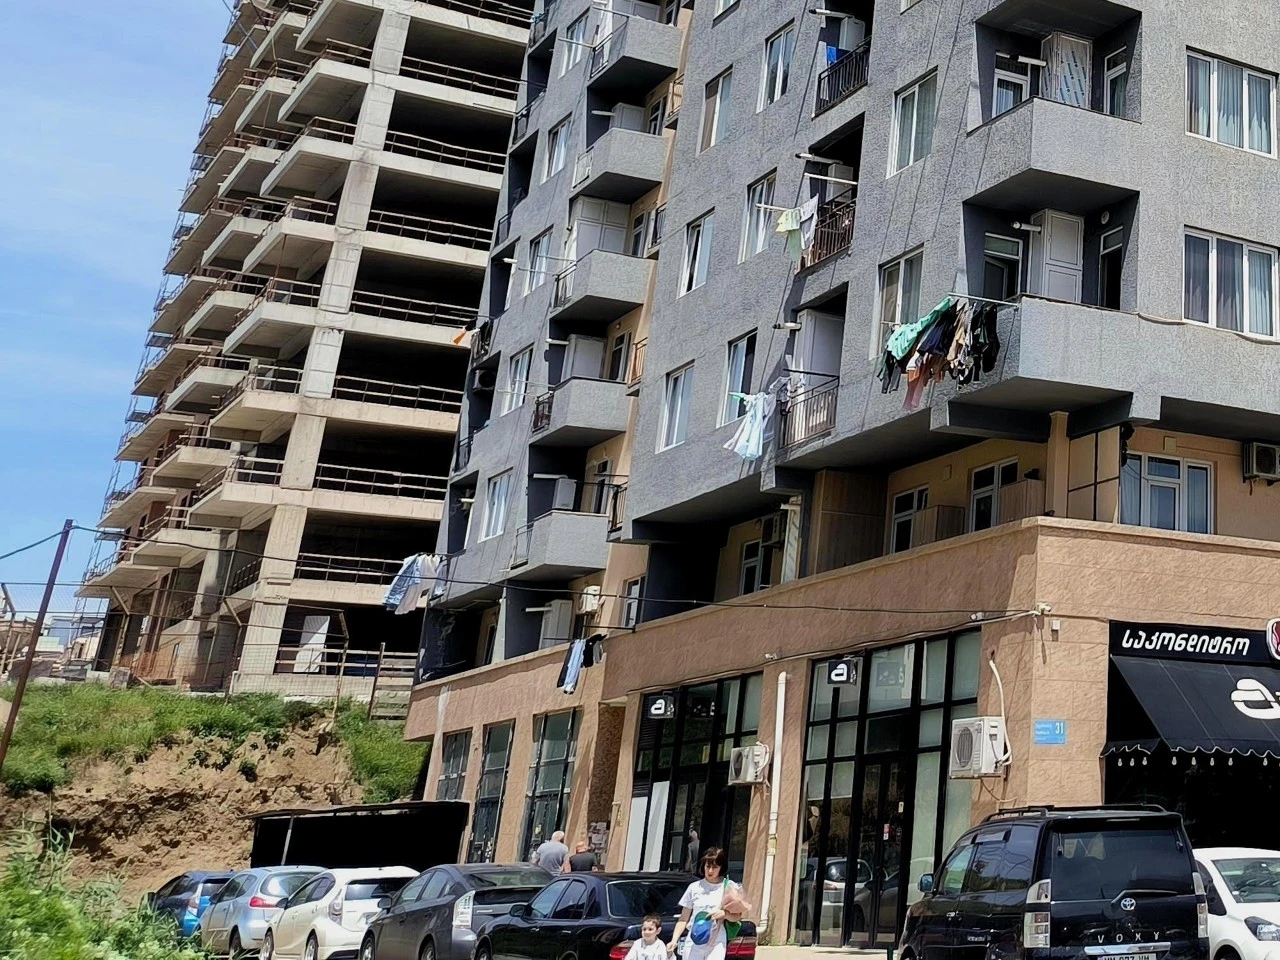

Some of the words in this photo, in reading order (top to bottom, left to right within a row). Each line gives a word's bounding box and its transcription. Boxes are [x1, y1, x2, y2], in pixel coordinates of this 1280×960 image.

[1121, 629, 1250, 656] საკონდიტრო
[1055, 722, 1064, 734] 31
[1097, 931, 1160, 944] VOXY
